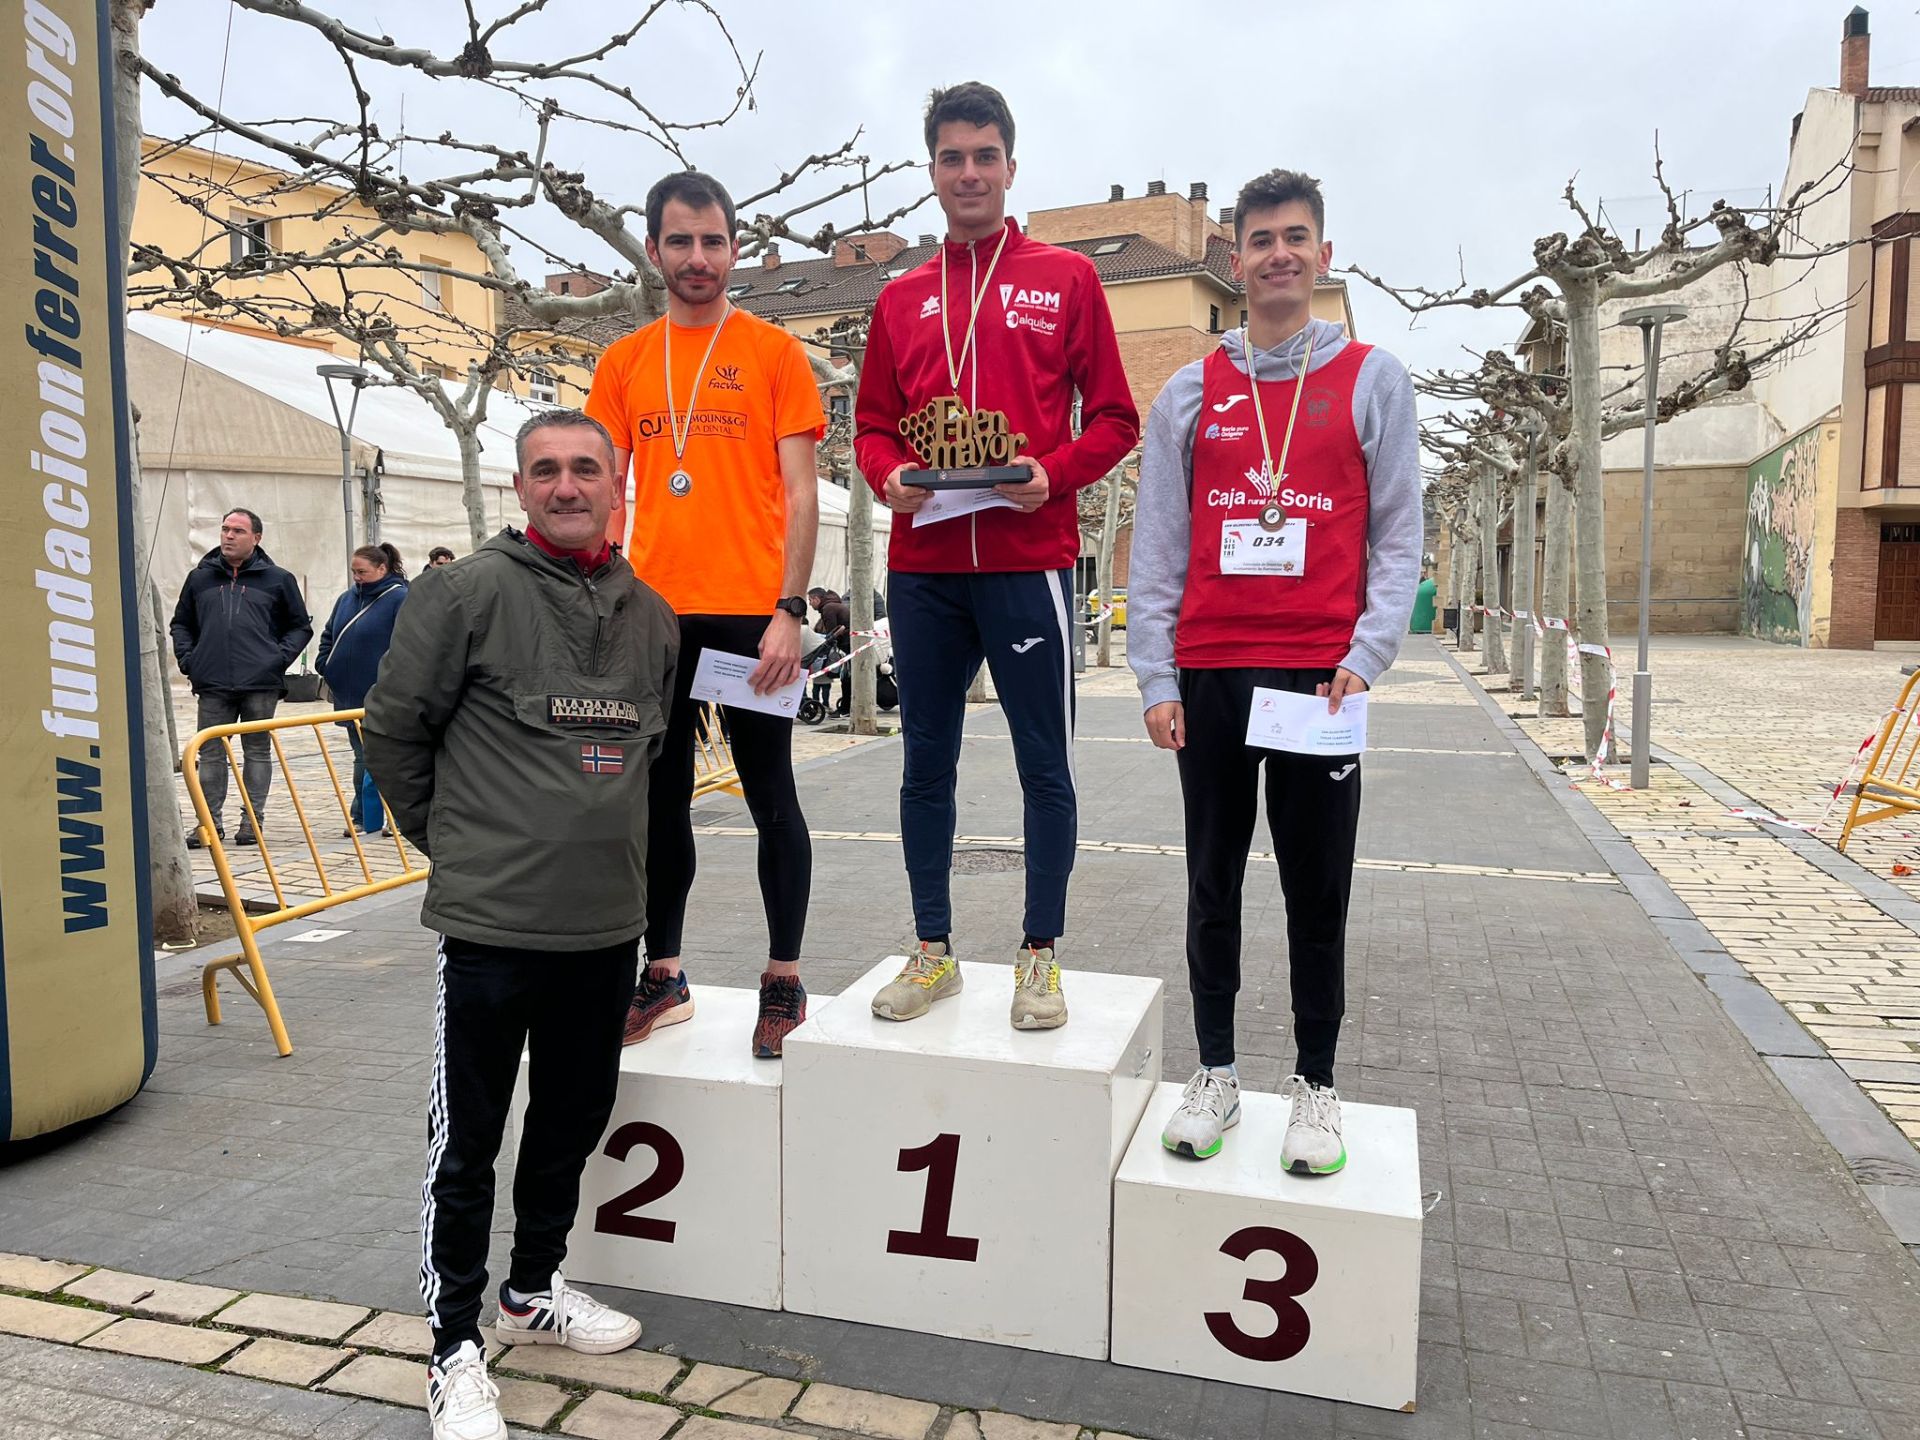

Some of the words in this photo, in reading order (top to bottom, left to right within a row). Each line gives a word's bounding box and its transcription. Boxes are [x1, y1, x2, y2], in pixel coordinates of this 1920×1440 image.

[1014, 289, 1060, 308] ADM
[1019, 313, 1058, 331] alquiber
[932, 396, 1009, 442] Fuen
[929, 432, 1028, 470] mayor
[24, 0, 109, 934] www.fundacionferrer.org
[1208, 488, 1246, 509] Caja
[1280, 488, 1333, 512] Soria
[1252, 536, 1286, 547] 034
[553, 698, 640, 721] NAPAPIJRI
[596, 1122, 685, 1243] 2
[886, 1133, 979, 1262] 1
[1204, 1226, 1319, 1361] 3
